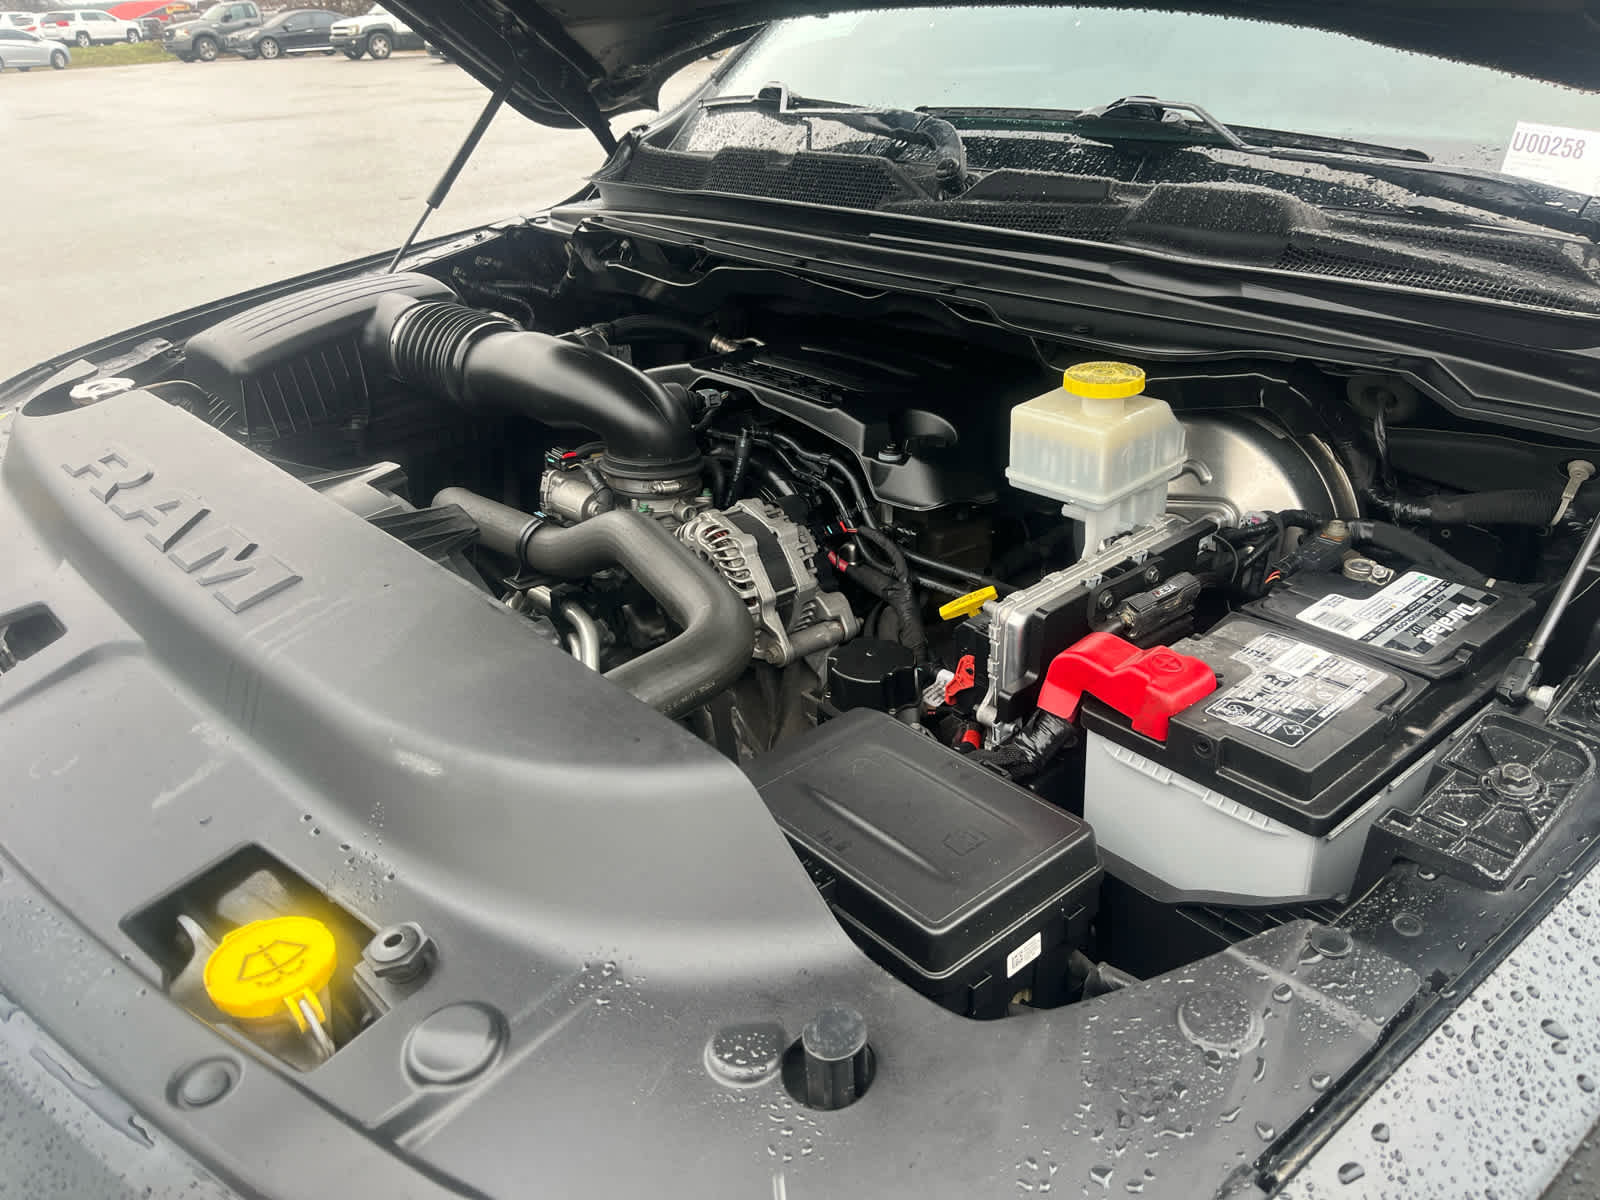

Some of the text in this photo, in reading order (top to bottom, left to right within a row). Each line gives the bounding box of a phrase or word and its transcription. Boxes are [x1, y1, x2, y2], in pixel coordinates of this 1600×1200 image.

[1512, 131, 1586, 160] U00258
[61, 449, 303, 614] RAM
[1416, 602, 1481, 645] Duralast
